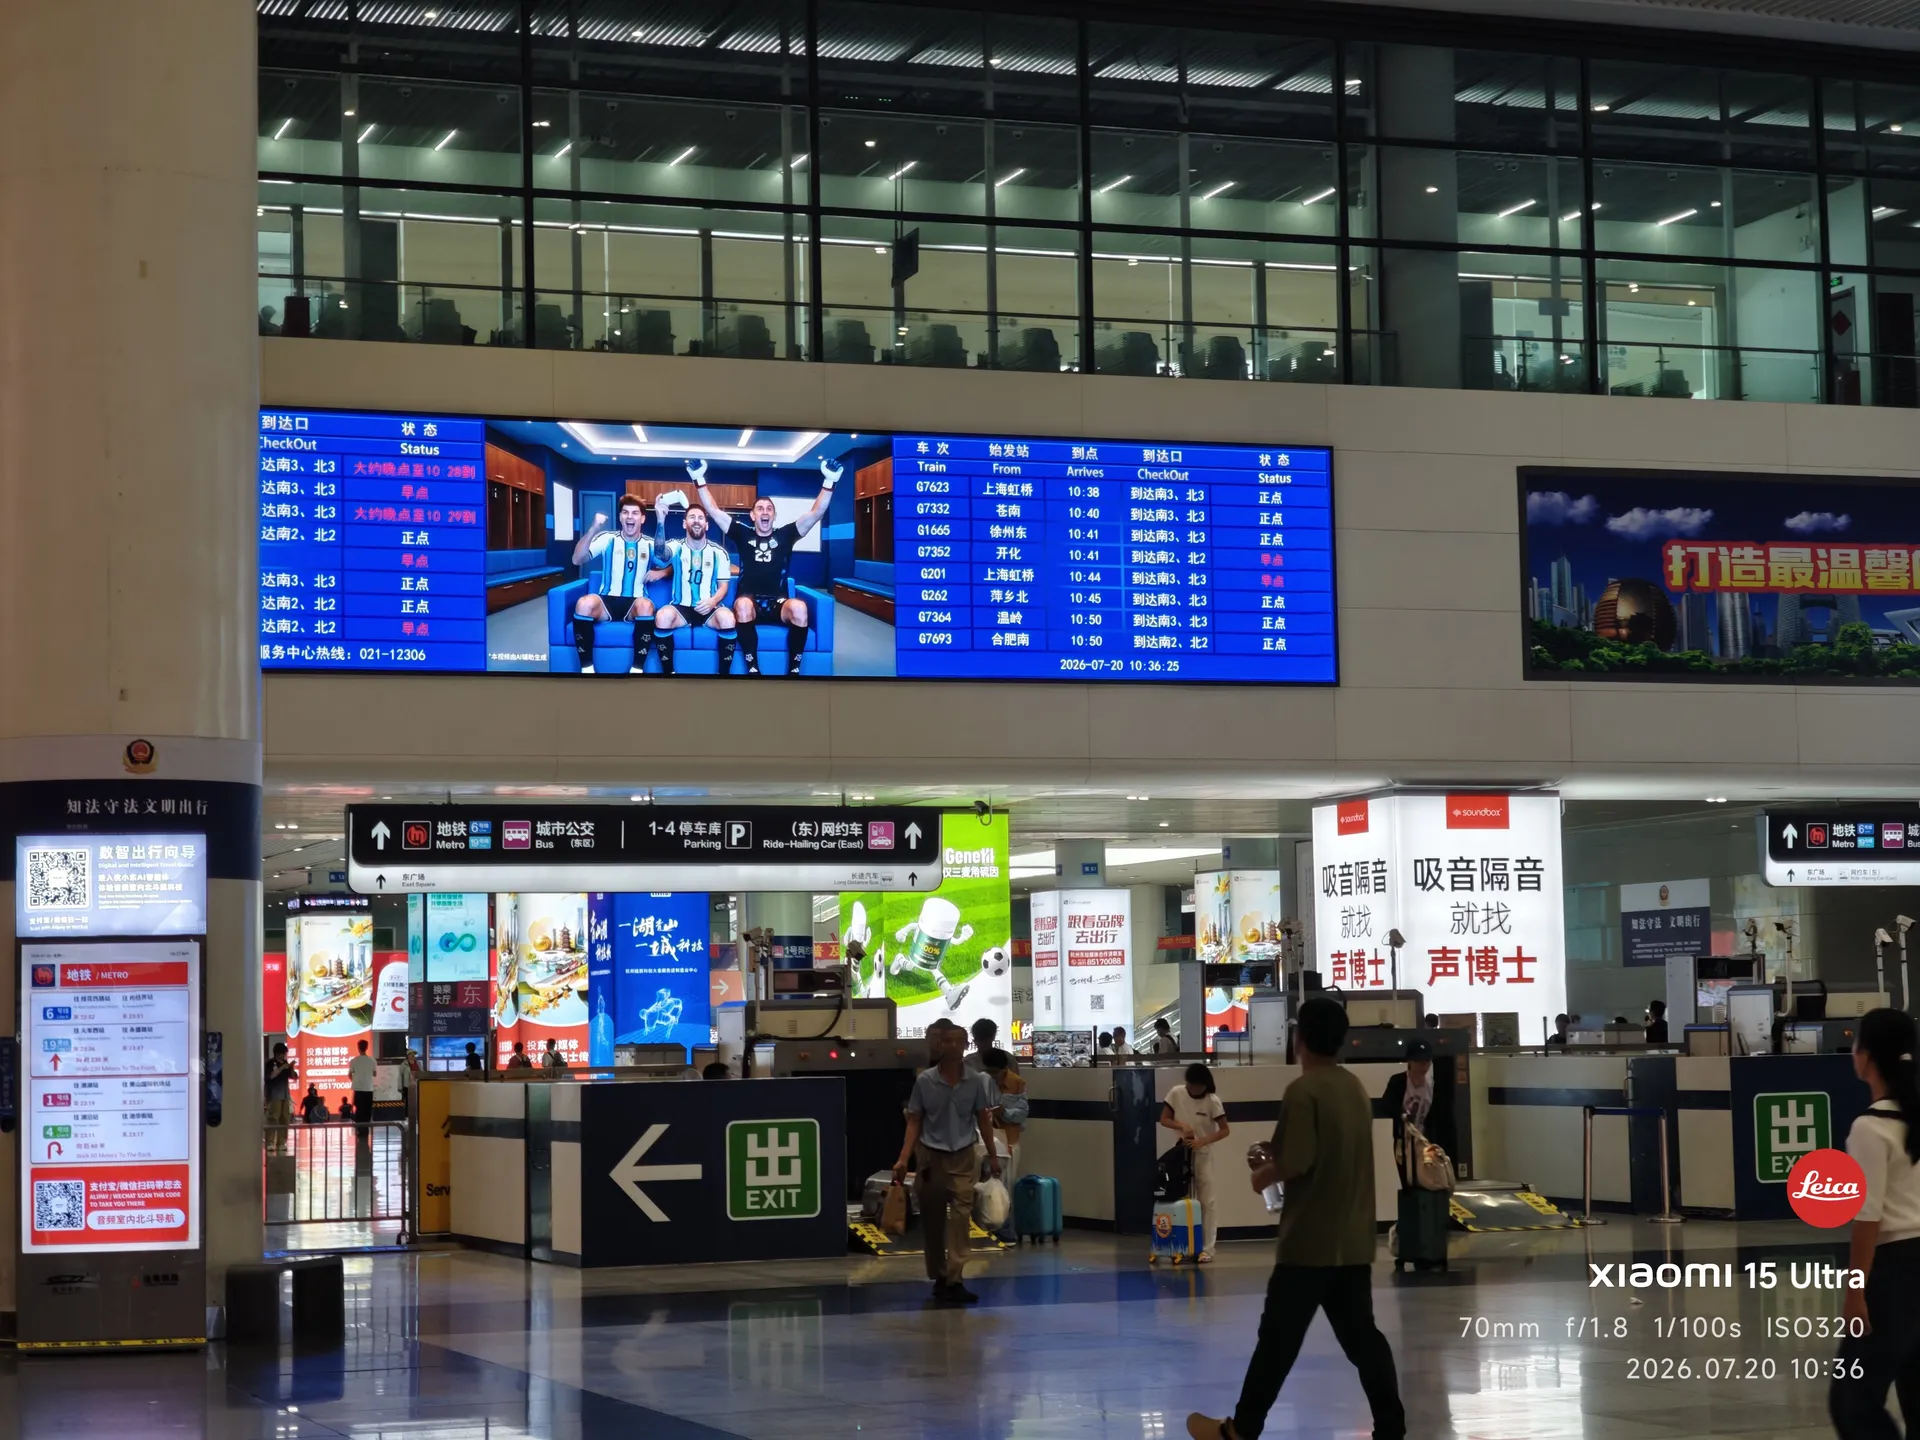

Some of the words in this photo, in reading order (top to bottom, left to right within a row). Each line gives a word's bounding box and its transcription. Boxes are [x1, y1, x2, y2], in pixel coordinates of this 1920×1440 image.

[262, 415, 308, 431] 到达口
[400, 443, 440, 456] Status
[989, 443, 1030, 458] 始发站
[1071, 447, 1098, 460] 到点
[1143, 449, 1182, 463] 到达口
[917, 461, 946, 473] Train
[993, 463, 1021, 475] From
[1066, 466, 1104, 478] Arrives
[1137, 469, 1189, 481] CheckOut
[1259, 473, 1292, 484] Status
[401, 485, 430, 499] 早点
[916, 481, 949, 493] G7623
[982, 483, 1033, 497] 上海虹桥
[1068, 487, 1100, 498] 10:38
[1259, 492, 1282, 504] 正点
[917, 503, 950, 515] G7332
[996, 504, 1021, 518] 苍南
[1068, 508, 1100, 519] 10:40
[1260, 513, 1283, 525] 正点
[401, 531, 430, 545] 正点
[917, 525, 950, 536] G1665
[990, 525, 1027, 539] 徐州东
[1068, 529, 1099, 540] 10:41
[1260, 534, 1284, 546] 正点
[401, 553, 429, 568] 早点
[755, 550, 772, 563] 23
[918, 546, 951, 558] G7352
[996, 547, 1022, 560] 开化
[1069, 550, 1099, 561] 10:41
[1261, 554, 1284, 566] 早点
[627, 560, 634, 573] 9
[1668, 545, 1920, 590] 打造最温馨
[401, 577, 430, 591] 正点
[688, 569, 703, 585] 10
[920, 568, 946, 580] G201
[983, 568, 1035, 583] 上海虹桥
[1069, 572, 1101, 583] 10:44
[1261, 575, 1284, 587] 早点
[921, 590, 948, 601] G262
[990, 589, 1029, 604] 萍乡北
[1069, 593, 1101, 604] 10:45
[1262, 597, 1285, 609] 正点
[401, 600, 430, 614] 正点
[918, 611, 951, 623] G7364
[997, 611, 1023, 625] 温岭
[1070, 614, 1102, 625] 10:50
[1262, 617, 1286, 630] 正点
[402, 622, 430, 636] 早点
[919, 633, 952, 644] G7693
[991, 632, 1030, 646] 合肥南
[1071, 636, 1102, 647] 10:50
[1263, 638, 1286, 651] 正点
[1060, 659, 1123, 672] 2026-07-20
[1130, 661, 1179, 672] 10:36:25
[66, 798, 208, 815] 知法守法文明出行
[1463, 808, 1501, 817] soundbox
[1344, 812, 1364, 823] soundbox
[437, 821, 467, 836] 地铁
[471, 822, 478, 833] 6
[535, 821, 595, 837] 城市公交
[649, 822, 676, 836] 1-4
[679, 821, 722, 836] 停车库
[1833, 824, 1856, 837] 地铁
[1859, 825, 1865, 834] 6
[436, 840, 465, 849] Metro
[535, 840, 554, 849] Bus
[684, 839, 721, 850] Parking
[763, 839, 820, 850] Ride-Hailing
[821, 840, 837, 849] Car
[838, 840, 864, 850] (East)
[1832, 840, 1855, 848] Metro
[99, 845, 195, 860] 数智出行向导
[402, 873, 425, 881] 东广场
[852, 872, 878, 880] 长途汽车
[1322, 858, 1387, 898] 吸音隔音
[1413, 856, 1545, 892] 吸音隔音
[1068, 915, 1124, 928] 跟着品牌
[1341, 904, 1372, 938] 就找
[1450, 901, 1512, 935] 就找
[1631, 917, 1662, 930] 知法守法
[1669, 914, 1700, 928] 文明出行
[1038, 932, 1055, 945] 去出行
[1076, 930, 1118, 943] 去出行
[1331, 948, 1385, 988] 声博士
[1427, 946, 1538, 987] 声博士
[67, 969, 92, 981] 地铁
[101, 971, 128, 979] METRO
[433, 985, 451, 995] 换乘
[463, 985, 482, 1004] 东
[433, 996, 451, 1004] 大厅
[46, 1008, 54, 1019] 6
[469, 1011, 481, 1032] 2
[43, 1040, 57, 1050] 19
[307, 1047, 348, 1056] 投东站媒体
[527, 1039, 578, 1051] 投东媒体
[46, 1095, 54, 1106] 1
[46, 1127, 54, 1137] 4
[90, 1180, 182, 1191] 支付宝/微信扫码带您去
[746, 1188, 801, 1210] EXIT
[97, 1214, 175, 1225] 音频室内北斗导航
